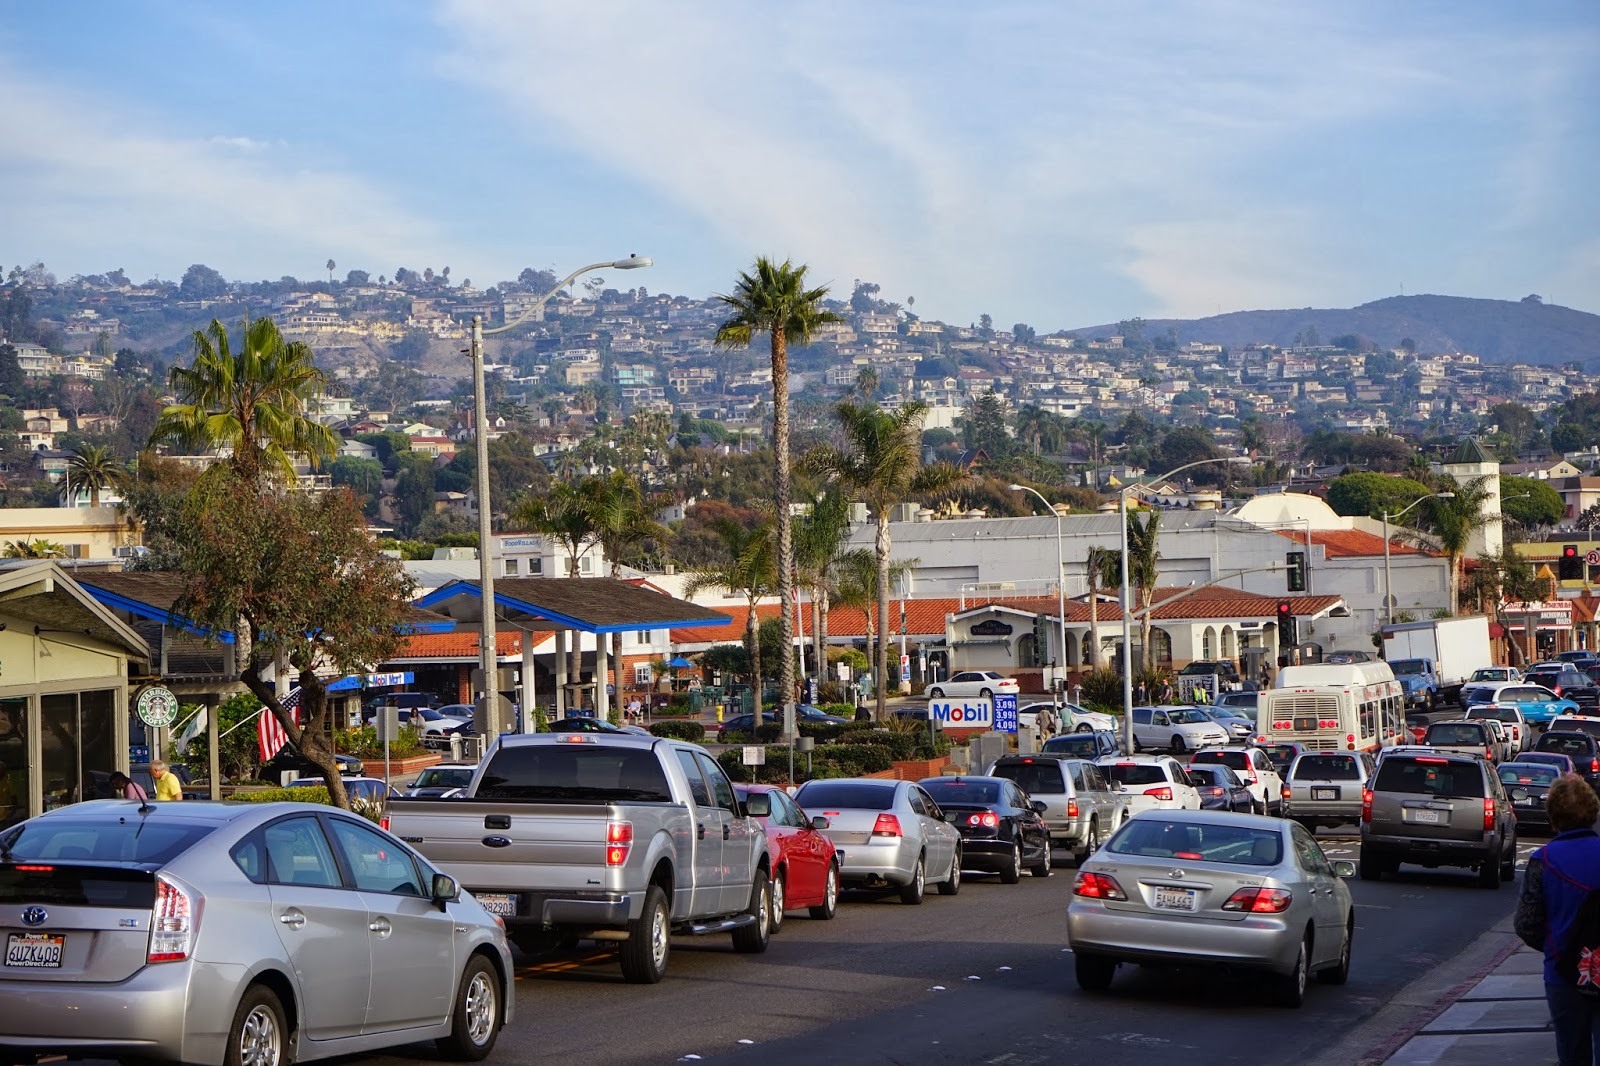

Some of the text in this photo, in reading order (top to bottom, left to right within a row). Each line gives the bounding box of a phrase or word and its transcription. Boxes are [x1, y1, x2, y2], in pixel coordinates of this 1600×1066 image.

[374, 674, 388, 686] Mobil
[141, 689, 176, 706] STARBUCKS
[144, 714, 172, 725] COFFEE
[933, 704, 988, 722] Mobil
[9, 946, 60, 962] 6UZK408
[6, 960, 58, 968] PowerDirect.com
